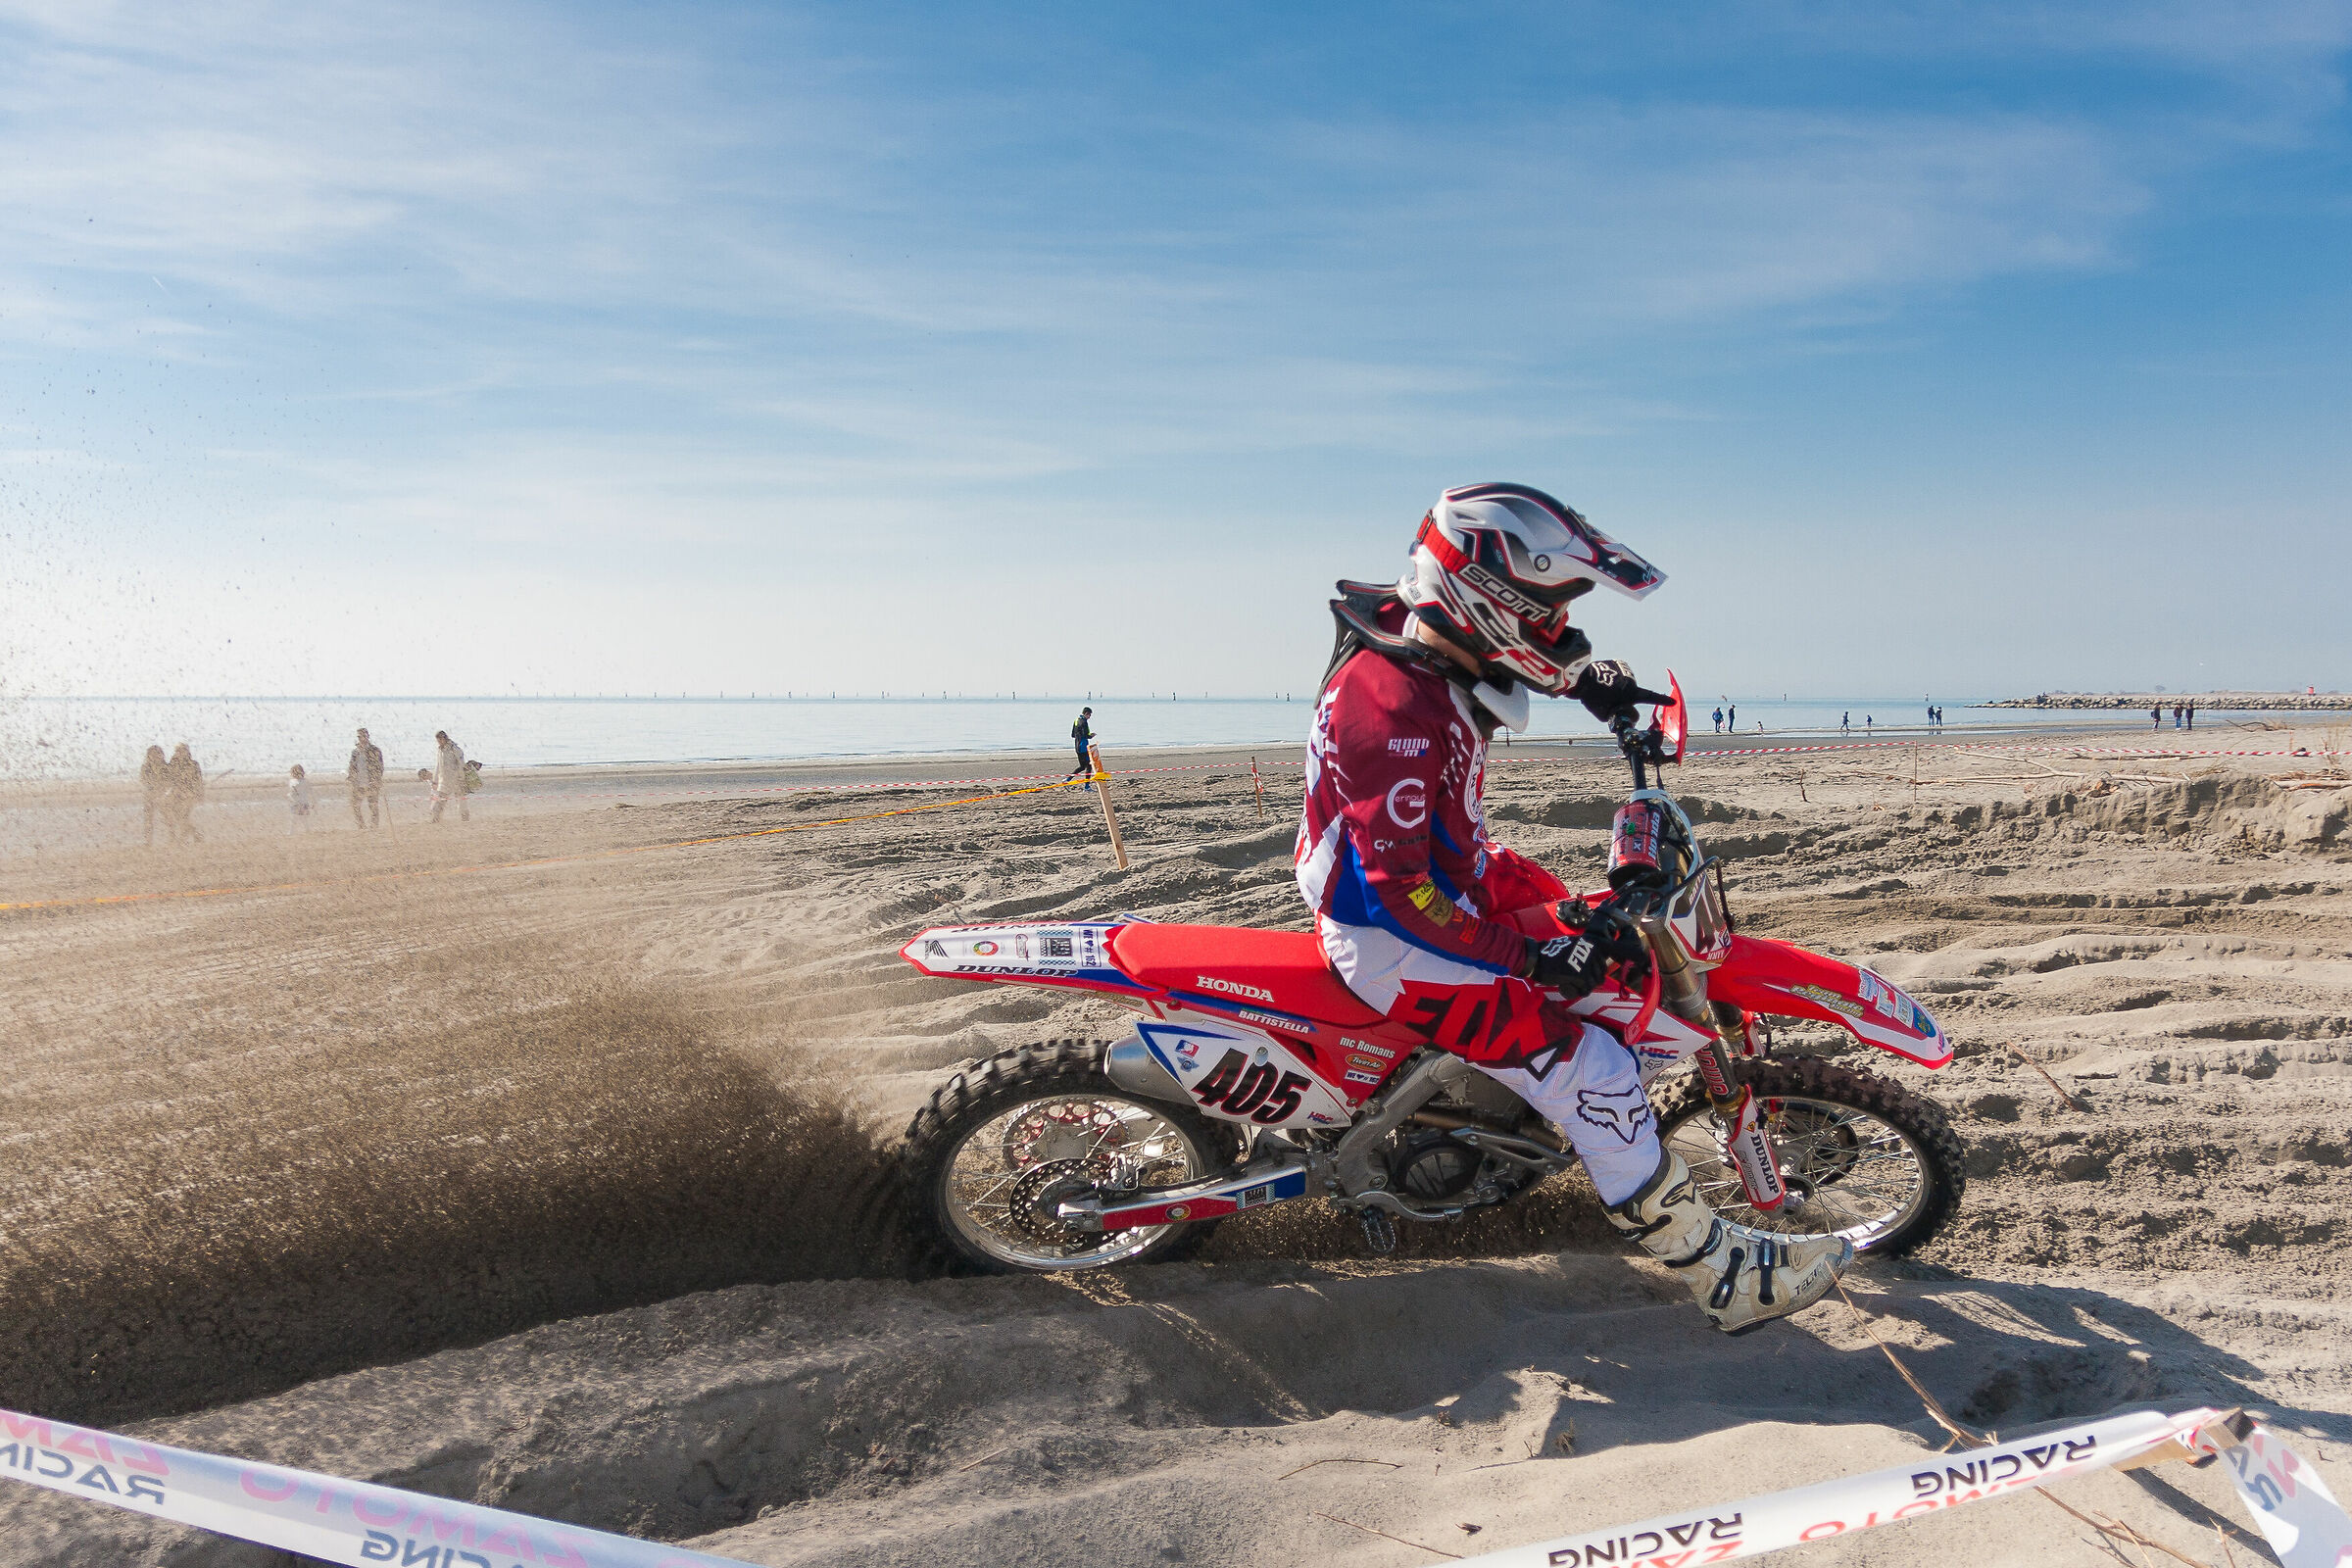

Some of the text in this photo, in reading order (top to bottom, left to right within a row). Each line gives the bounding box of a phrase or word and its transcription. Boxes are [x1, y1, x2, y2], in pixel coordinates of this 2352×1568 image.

[1461, 564, 1550, 621] SCOTT
[953, 964, 1078, 978] DUNLOP
[1568, 937, 1594, 973] FOX
[1196, 975, 1275, 1003] HONDA
[1238, 1009, 1310, 1034] BATTISTELLA
[1387, 977, 1547, 1062] FOX
[1339, 1037, 1396, 1059] mc Romans
[1639, 1045, 1680, 1060] HRC
[1191, 1047, 1313, 1125] 405
[1751, 1133, 1781, 1194] DUNLOP
[1911, 1435, 2097, 1499] RACING
[1547, 1511, 1744, 1568] RACING
